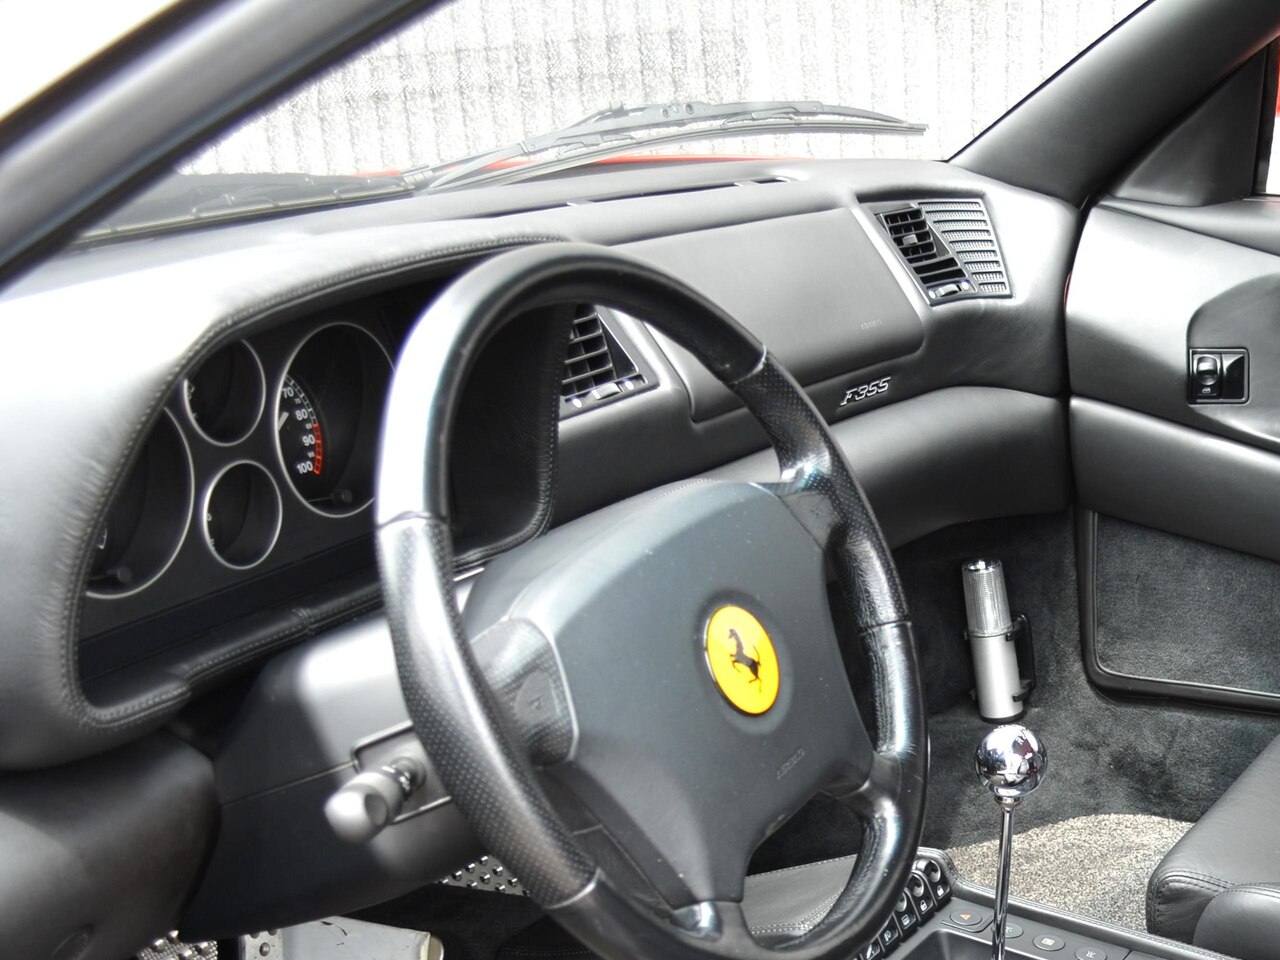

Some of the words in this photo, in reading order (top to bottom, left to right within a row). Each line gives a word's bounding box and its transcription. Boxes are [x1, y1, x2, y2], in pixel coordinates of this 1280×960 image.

[282, 386, 293, 399] 70
[840, 377, 891, 406] F355
[295, 409, 308, 420] 80
[302, 434, 315, 446] 90
[297, 461, 313, 474] 100
